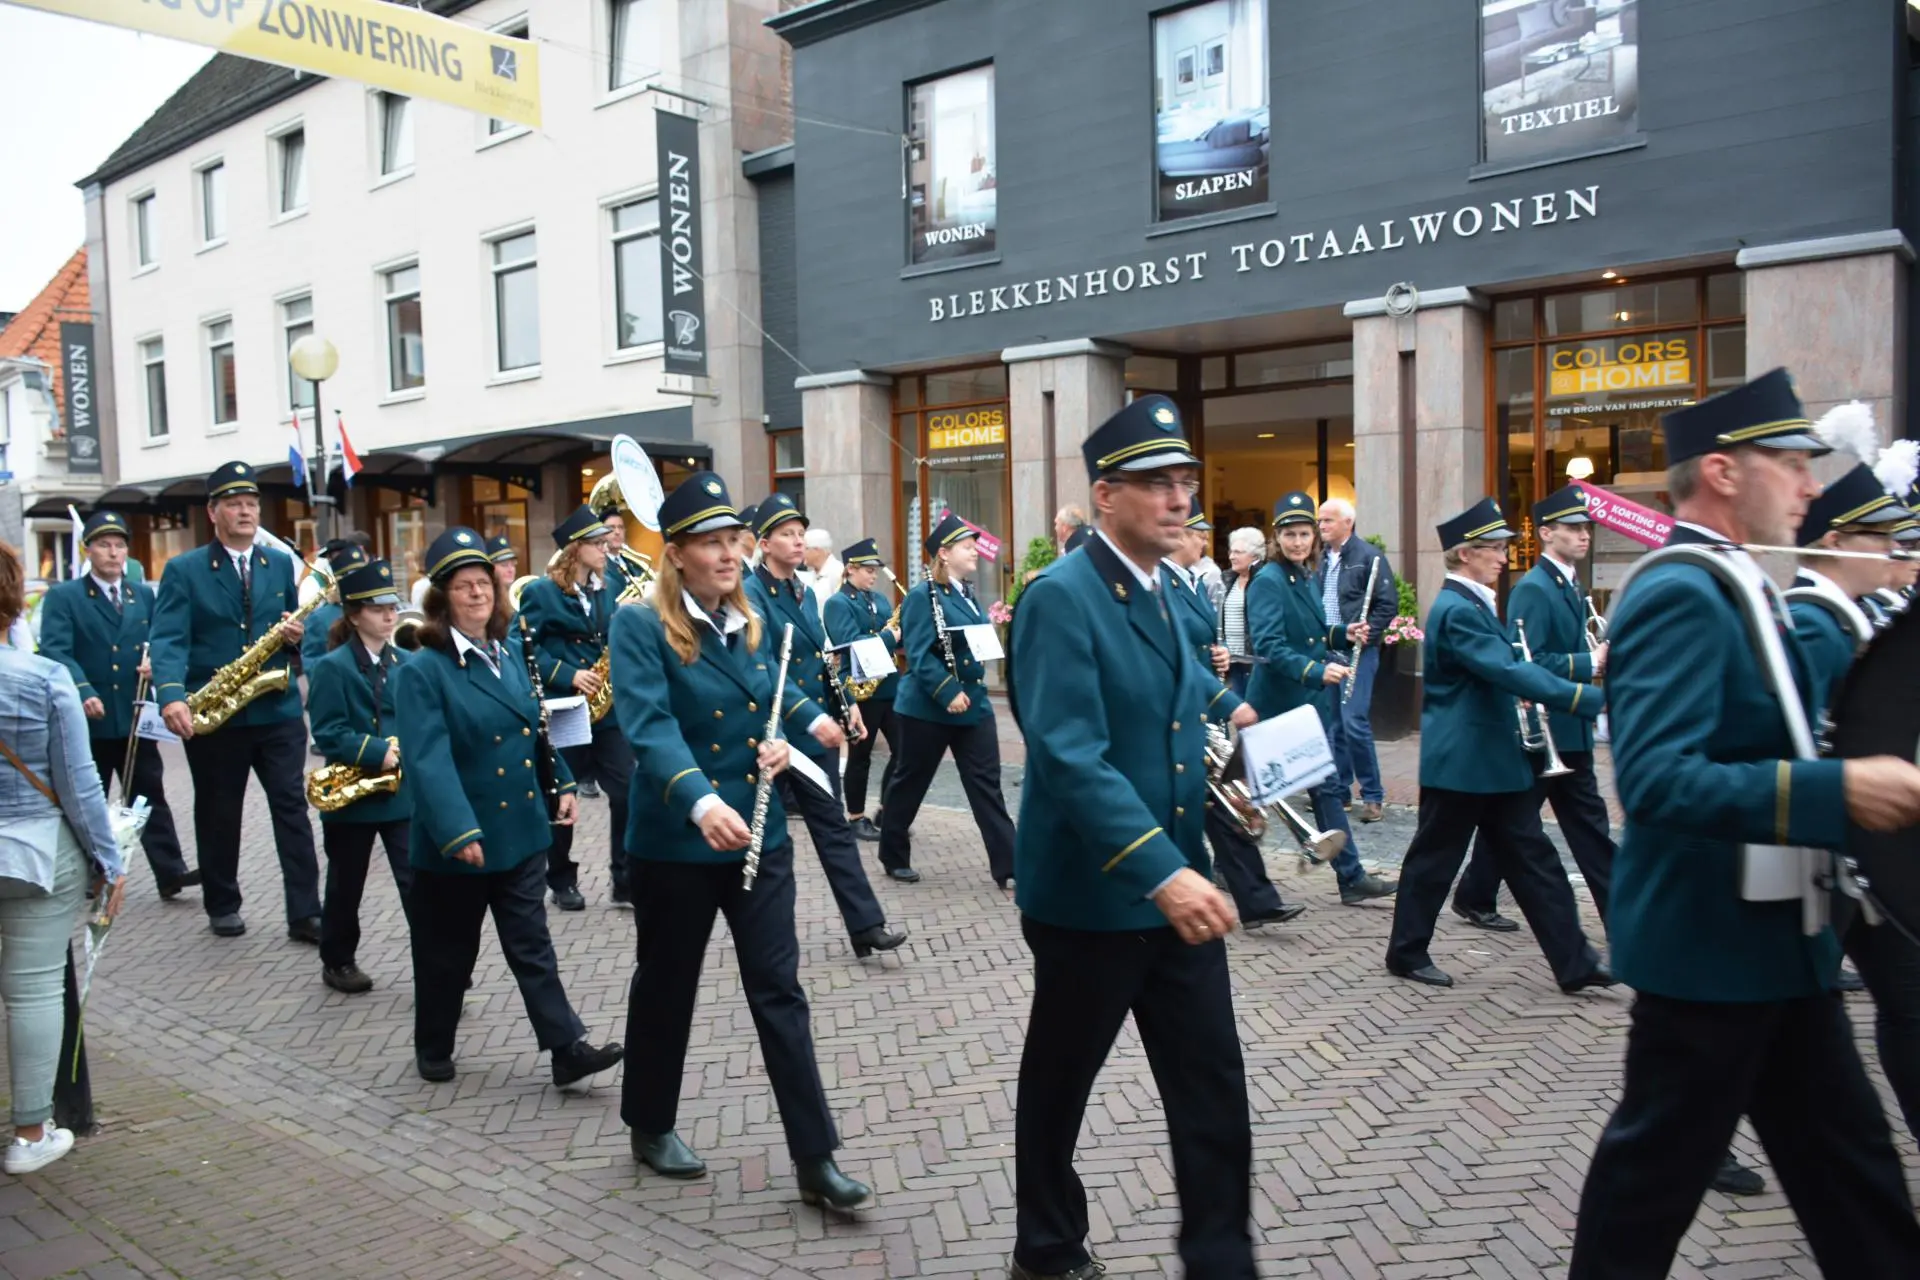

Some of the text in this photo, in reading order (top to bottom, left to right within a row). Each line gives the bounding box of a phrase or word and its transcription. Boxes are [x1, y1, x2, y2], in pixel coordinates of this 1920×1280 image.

[258, 0, 463, 82] ZONWERING
[1500, 95, 1620, 135] TEXTIEL
[1175, 170, 1253, 201] SLAPEN
[668, 150, 694, 296] WONEN
[925, 222, 986, 247] WONEN
[929, 185, 1600, 321] BLEKKENHORST TOTAALWONEN
[1552, 339, 1688, 370] COLORS
[69, 343, 91, 429] WONEN
[1580, 360, 1686, 393] HOME
[929, 409, 1003, 431] COLORS
[1550, 407, 1570, 416] EEN
[1573, 403, 1603, 414] BRON
[1604, 403, 1627, 412] VAN
[945, 425, 1005, 447] HOME
[1611, 504, 1671, 534] KORTING OP
